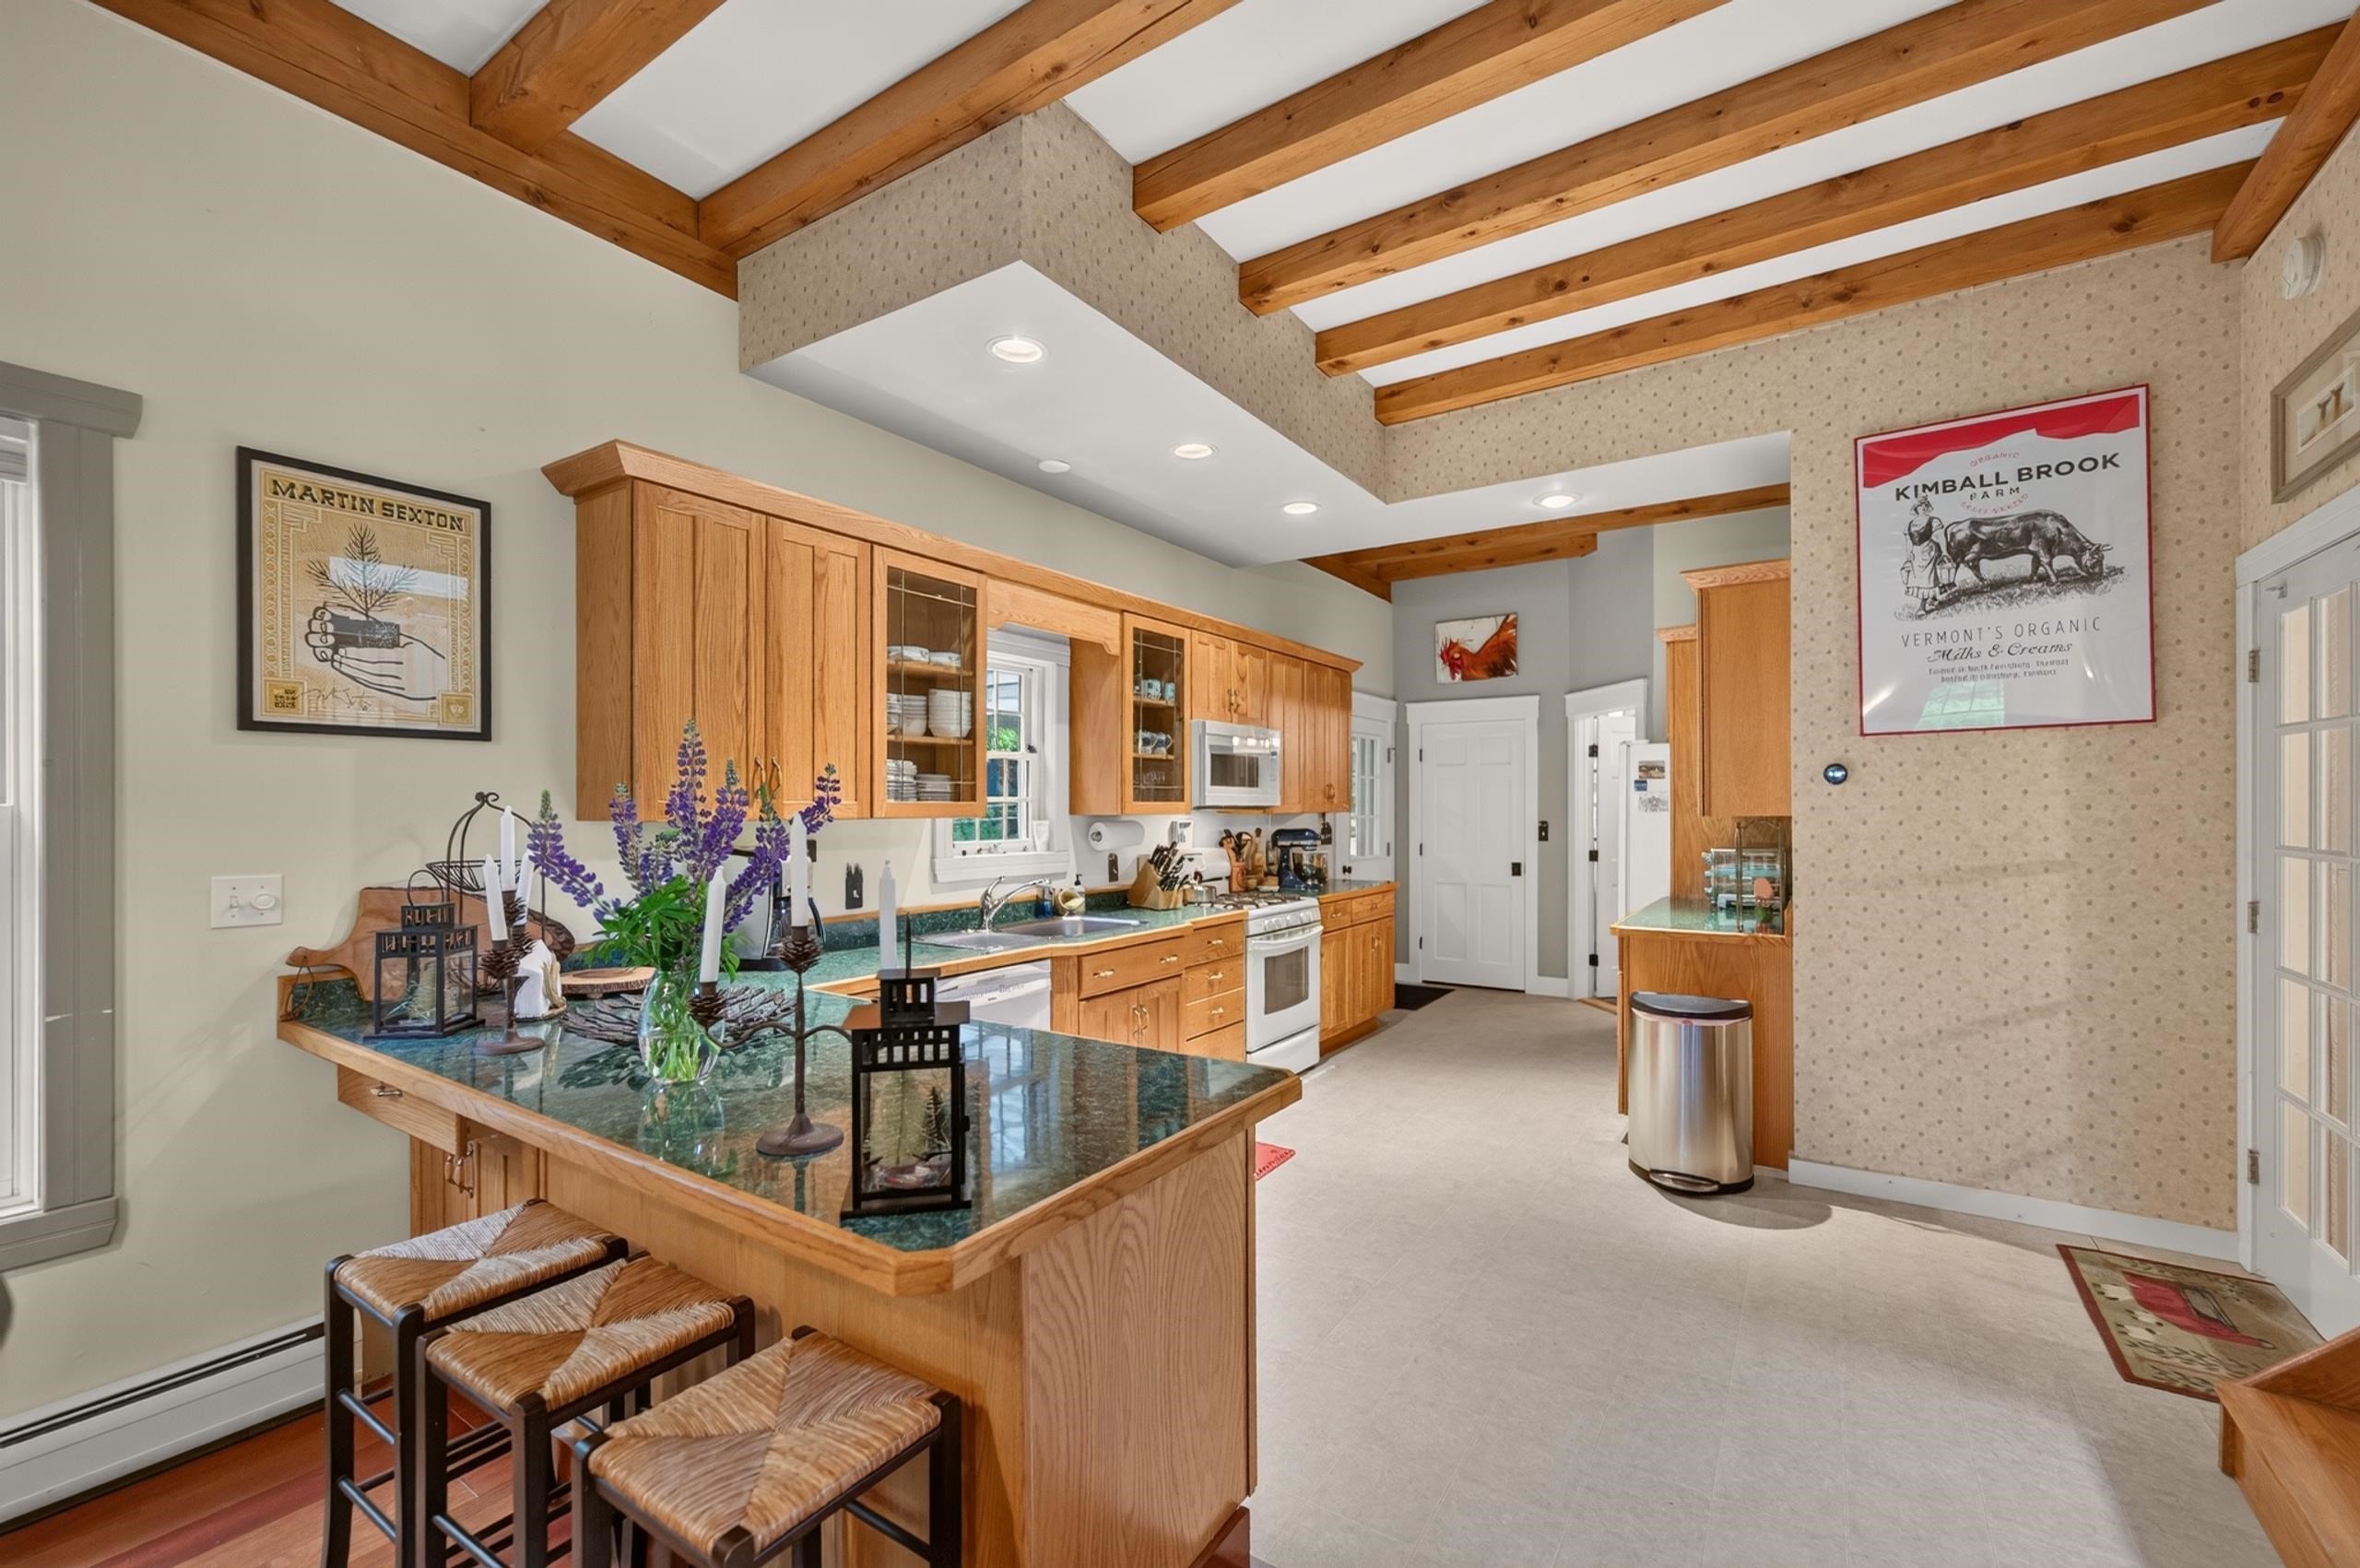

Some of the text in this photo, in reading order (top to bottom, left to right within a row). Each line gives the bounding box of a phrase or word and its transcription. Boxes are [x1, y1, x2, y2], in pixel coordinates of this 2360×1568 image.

[1895, 452, 2121, 501] KIMBALL BROOK
[272, 478, 465, 532] MARTIN SEXTON
[1969, 486, 2021, 501] FARM
[1901, 616, 2101, 648] VERMONT'S ORGANIC
[1927, 643, 2073, 663] Milks & Creams
